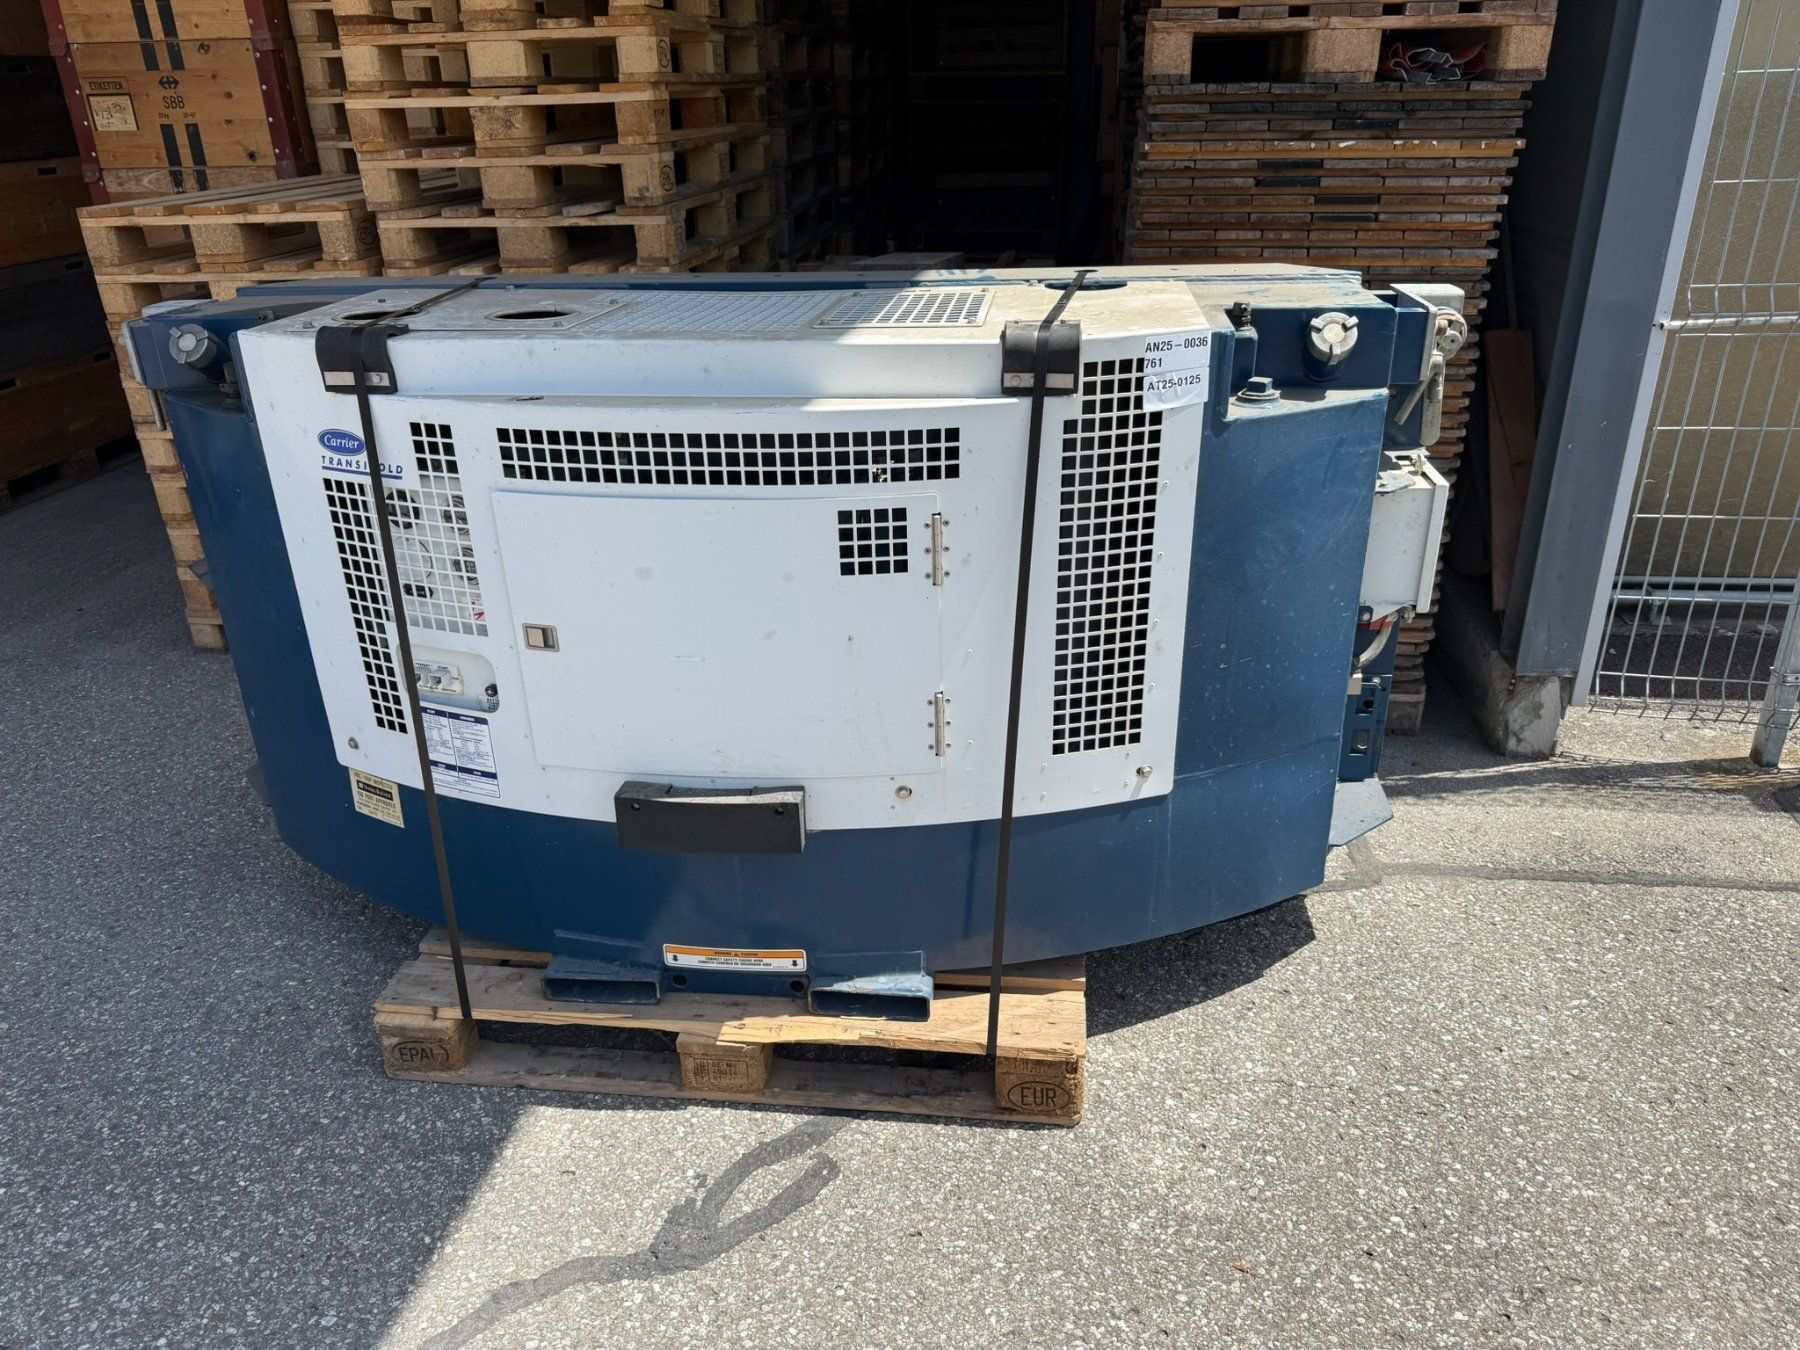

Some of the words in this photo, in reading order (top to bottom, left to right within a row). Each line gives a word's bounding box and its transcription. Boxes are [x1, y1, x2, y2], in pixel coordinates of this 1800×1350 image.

[89, 81, 124, 90] ETIKETTEN
[162, 95, 185, 109] SBB
[1145, 357, 1162, 369] 761
[1147, 373, 1201, 392] AT25-0125
[324, 434, 360, 449] Carrier
[321, 455, 403, 474] TRANSIOLD
[1021, 1086, 1057, 1107] EUR
